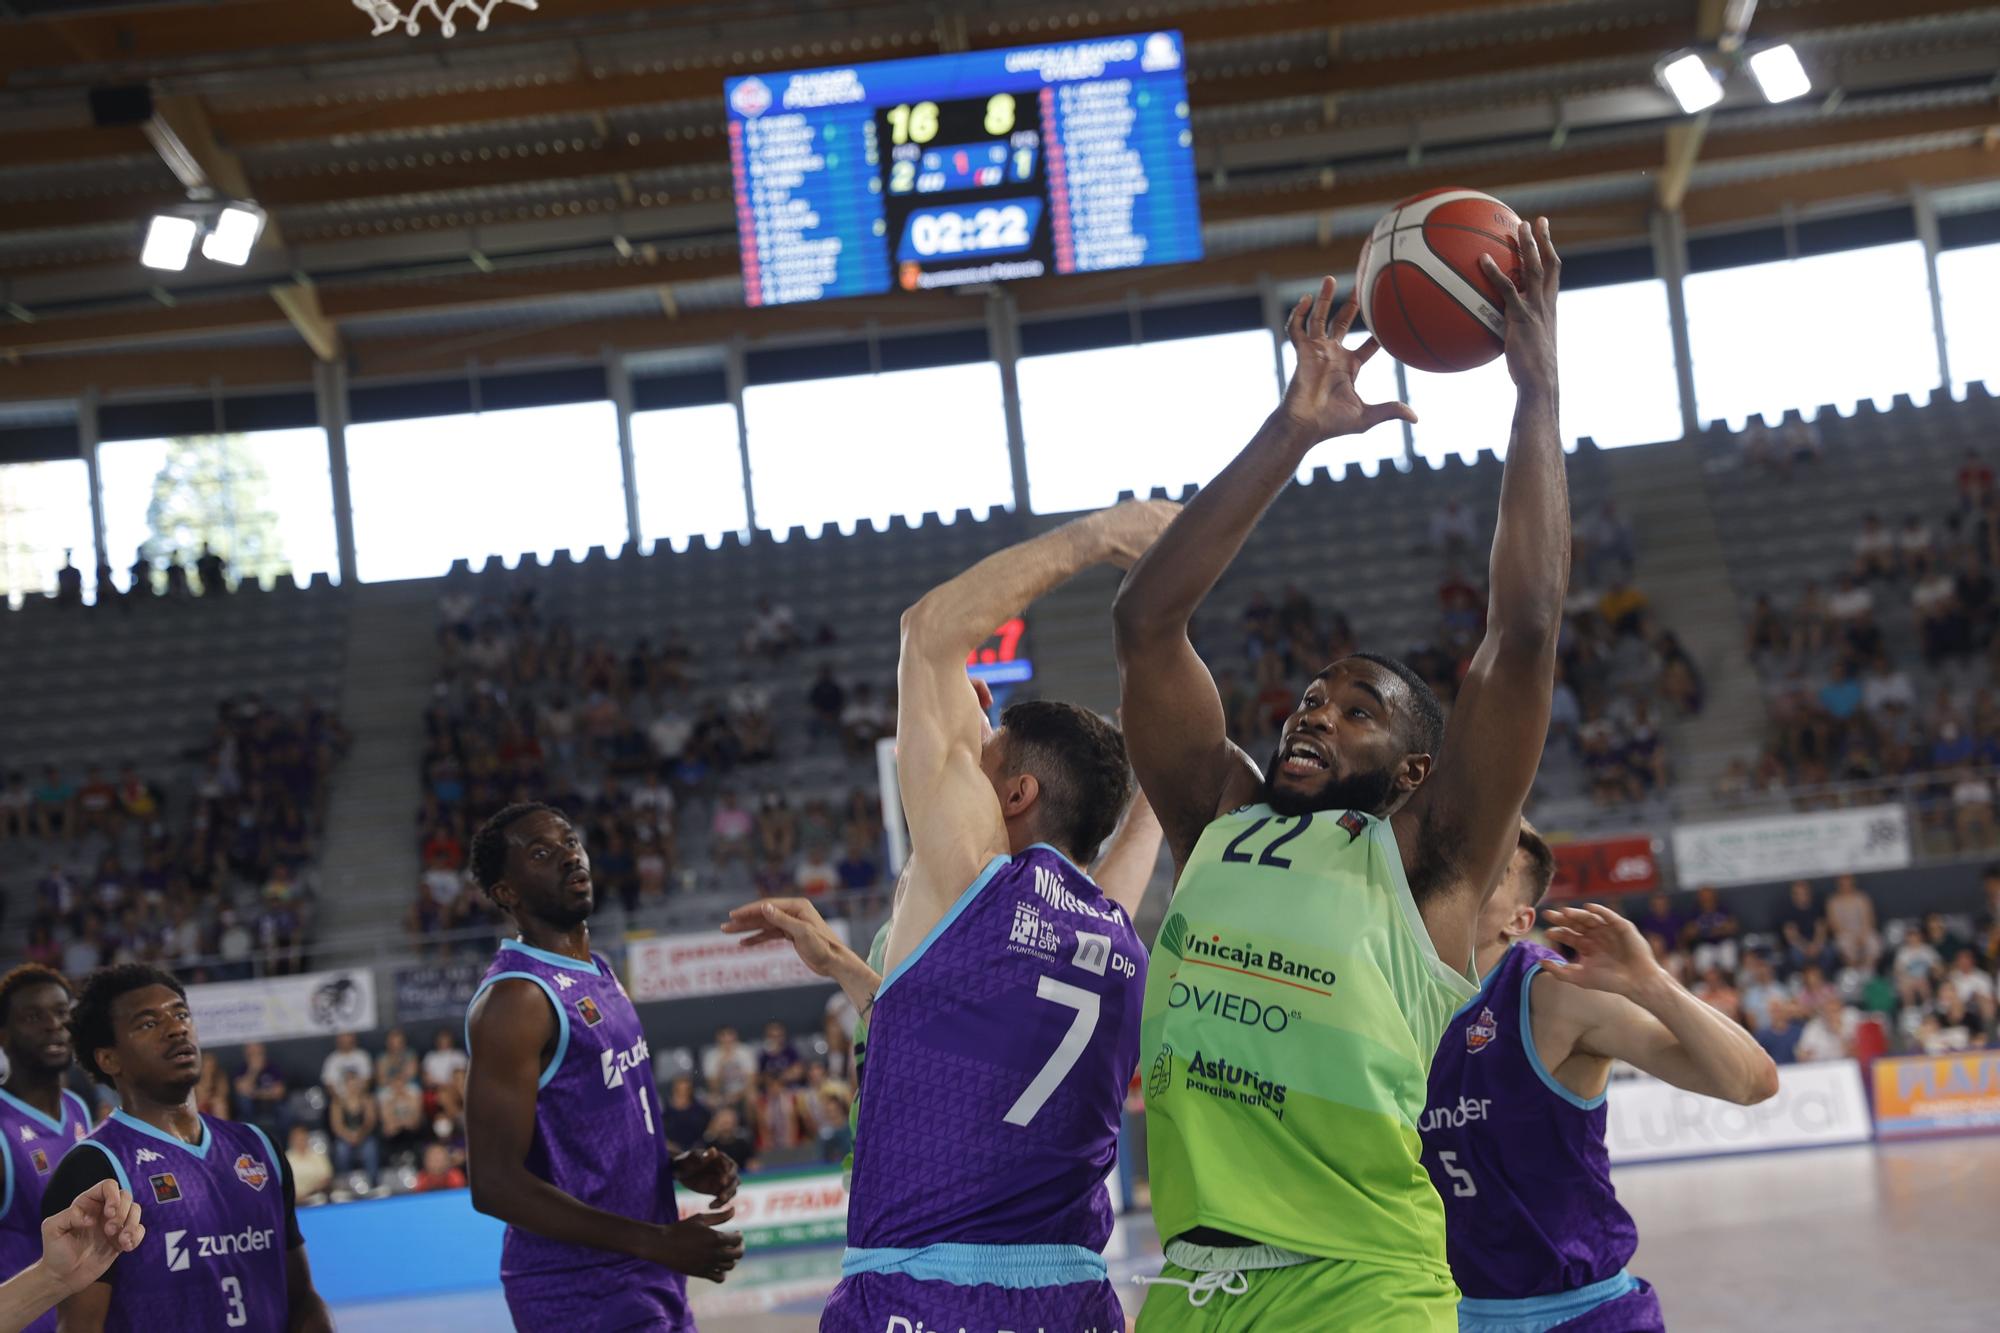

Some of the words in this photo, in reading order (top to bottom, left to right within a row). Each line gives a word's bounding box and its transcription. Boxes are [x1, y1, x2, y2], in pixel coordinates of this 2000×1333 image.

[887, 101, 940, 145] 16
[984, 93, 1016, 136] 8
[890, 160, 916, 192] 2
[1013, 148, 1032, 179] 1
[911, 205, 1030, 256] 02:22
[1222, 811, 1314, 869] 22
[1267, 951, 1336, 986] Banco
[1002, 975, 1101, 1127] 7
[1187, 1050, 1287, 1104] Asturias
[1418, 1096, 1492, 1132] under
[1439, 1151, 1477, 1197] 5
[197, 1226, 274, 1257] zunder
[221, 1276, 247, 1327] 3
